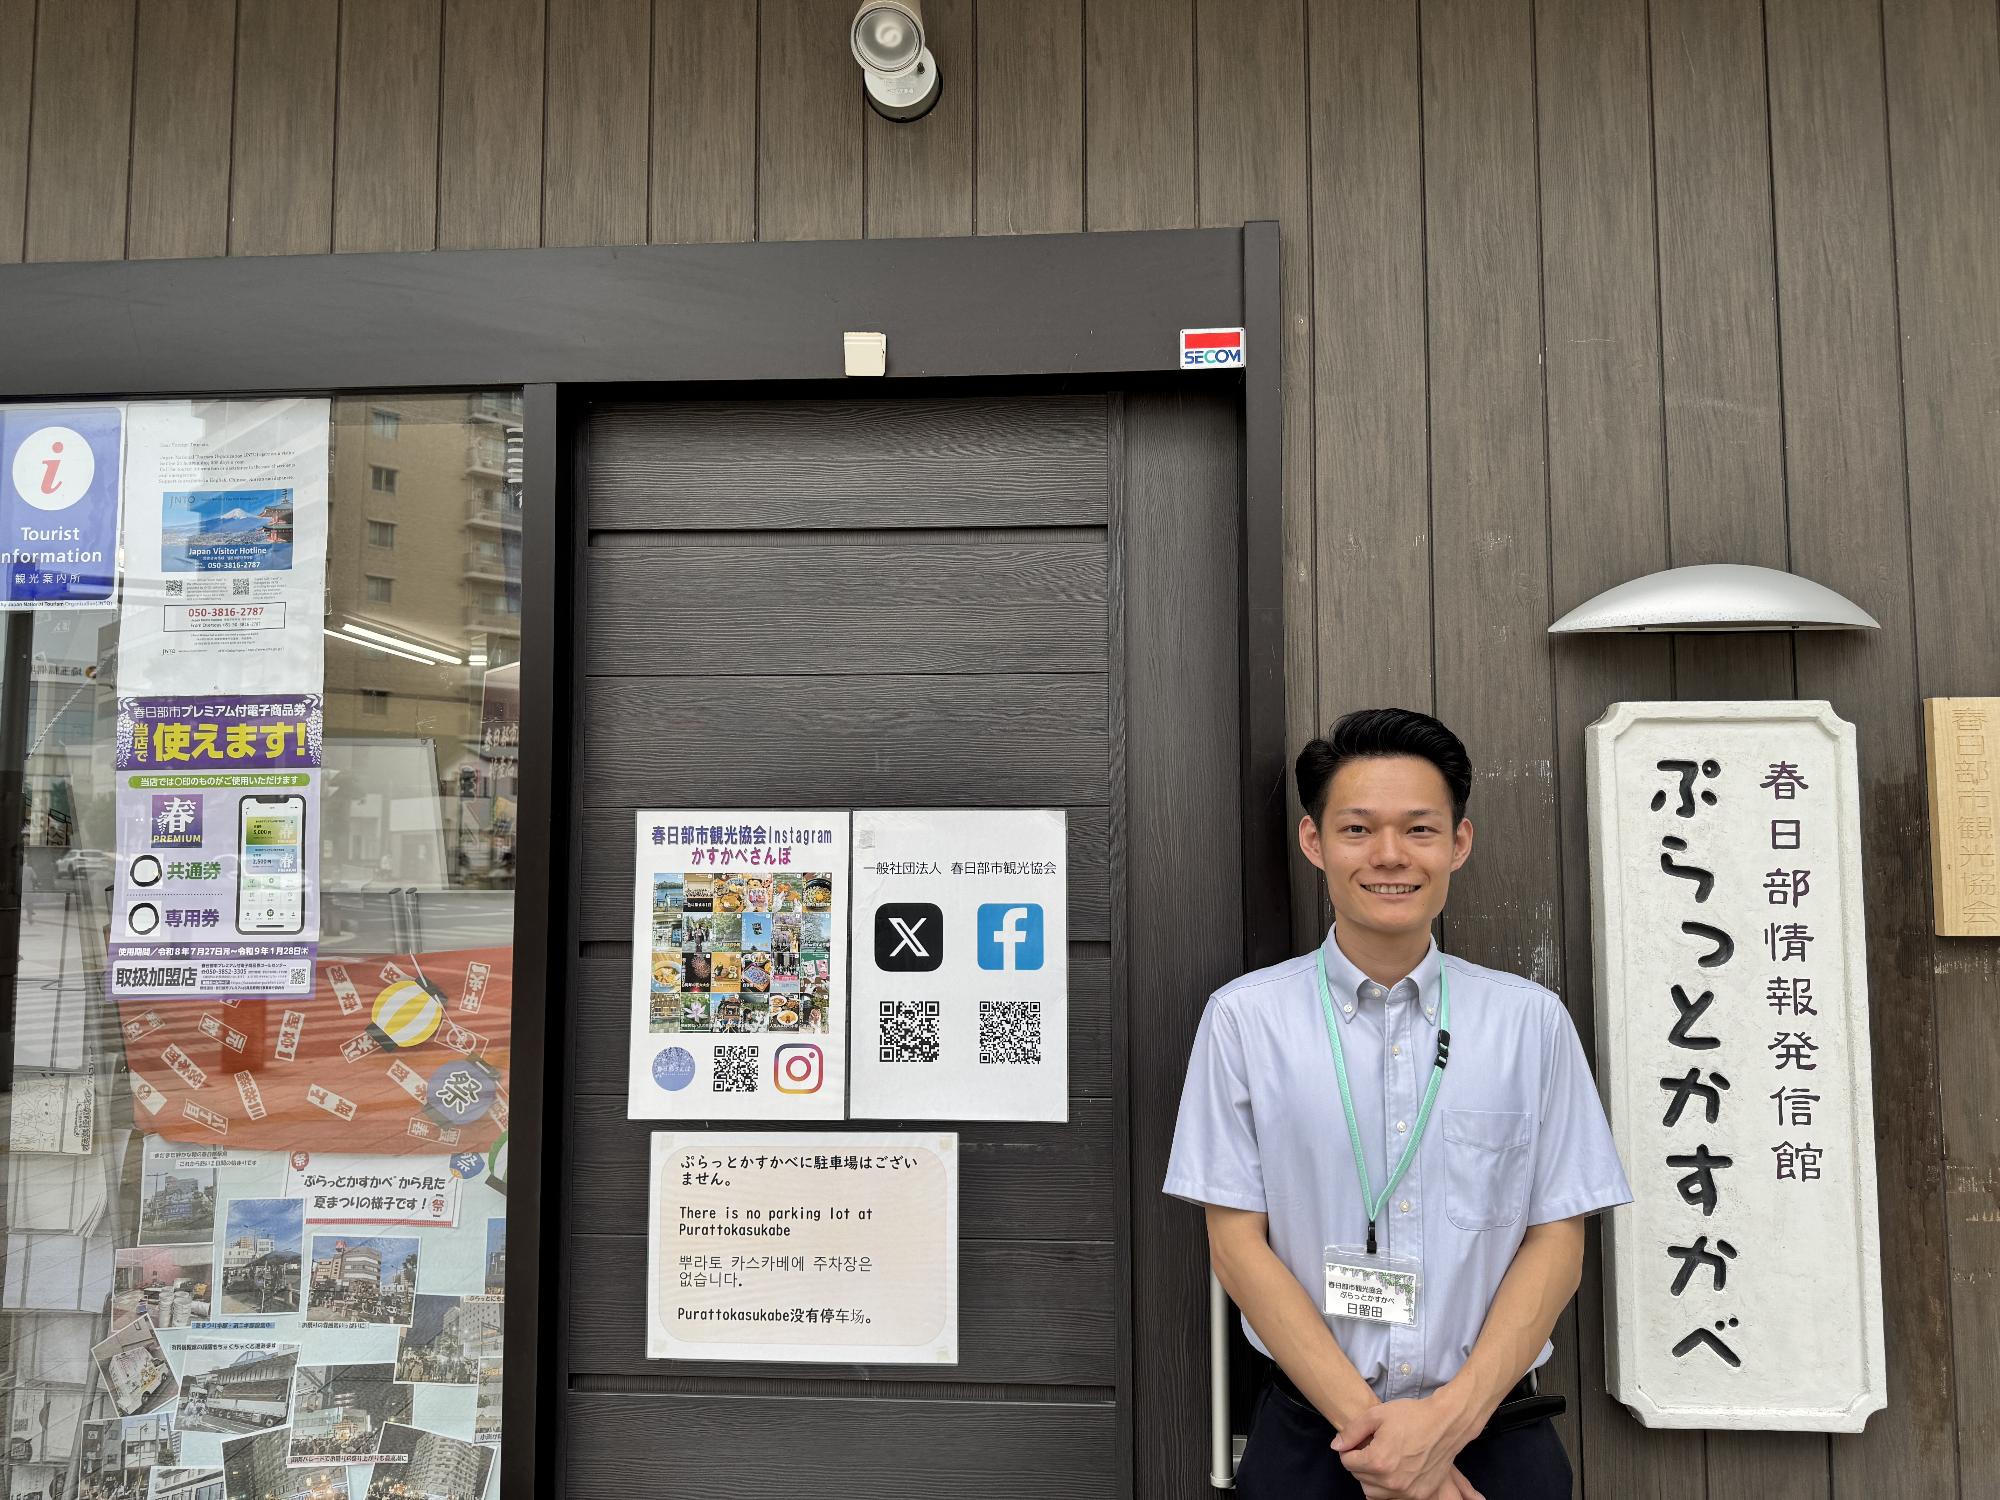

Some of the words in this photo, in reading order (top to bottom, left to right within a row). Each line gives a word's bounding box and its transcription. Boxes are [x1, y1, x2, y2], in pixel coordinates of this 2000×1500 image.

[1185, 350, 1241, 365] SECOM
[20, 526, 80, 541] Tourist
[0, 548, 103, 563] nformation
[189, 547, 211, 557] Japan
[212, 547, 238, 555] Visitor
[240, 546, 267, 554] Hotline
[207, 561, 261, 569] 050-3816-2787
[15, 573, 81, 584] 観光案内所
[188, 606, 265, 618] 050-3816-2787
[133, 703, 307, 719] 春日部市プレミアム付電子商品券
[134, 723, 149, 763] 当店で
[1951, 706, 1999, 927] 春日部市観光協会
[153, 834, 201, 843] PREMIUM
[651, 825, 832, 845] 春日部市観光協会Instagram
[167, 862, 221, 880] 共通券
[863, 861, 942, 876] 一般社団法人
[950, 861, 1057, 876] 春日部市観光協会
[165, 908, 219, 928] 専用券
[115, 967, 198, 988] 取扱加盟店
[1759, 759, 1824, 1183] 春日部情報発信館
[1649, 758, 1742, 1369] ぷらっとかすかべ
[435, 1070, 483, 1114] 祭
[680, 1154, 918, 1170] ぷらっとかすかべに駐車場はござい
[681, 1172, 732, 1187] ません。
[679, 1206, 716, 1220] There
[725, 1206, 739, 1220] is
[746, 1209, 761, 1220] no
[768, 1206, 821, 1222] parking
[829, 1206, 850, 1220] lot
[858, 1208, 873, 1220] at
[679, 1223, 791, 1237] Purattokasukabe
[678, 1254, 723, 1271] 뿌라토
[731, 1255, 805, 1272] 카스카베에
[813, 1255, 873, 1272] 주차장은
[679, 1271, 743, 1288] 없습니다.
[677, 1307, 872, 1324] Purattokasukabe没有停车场。
